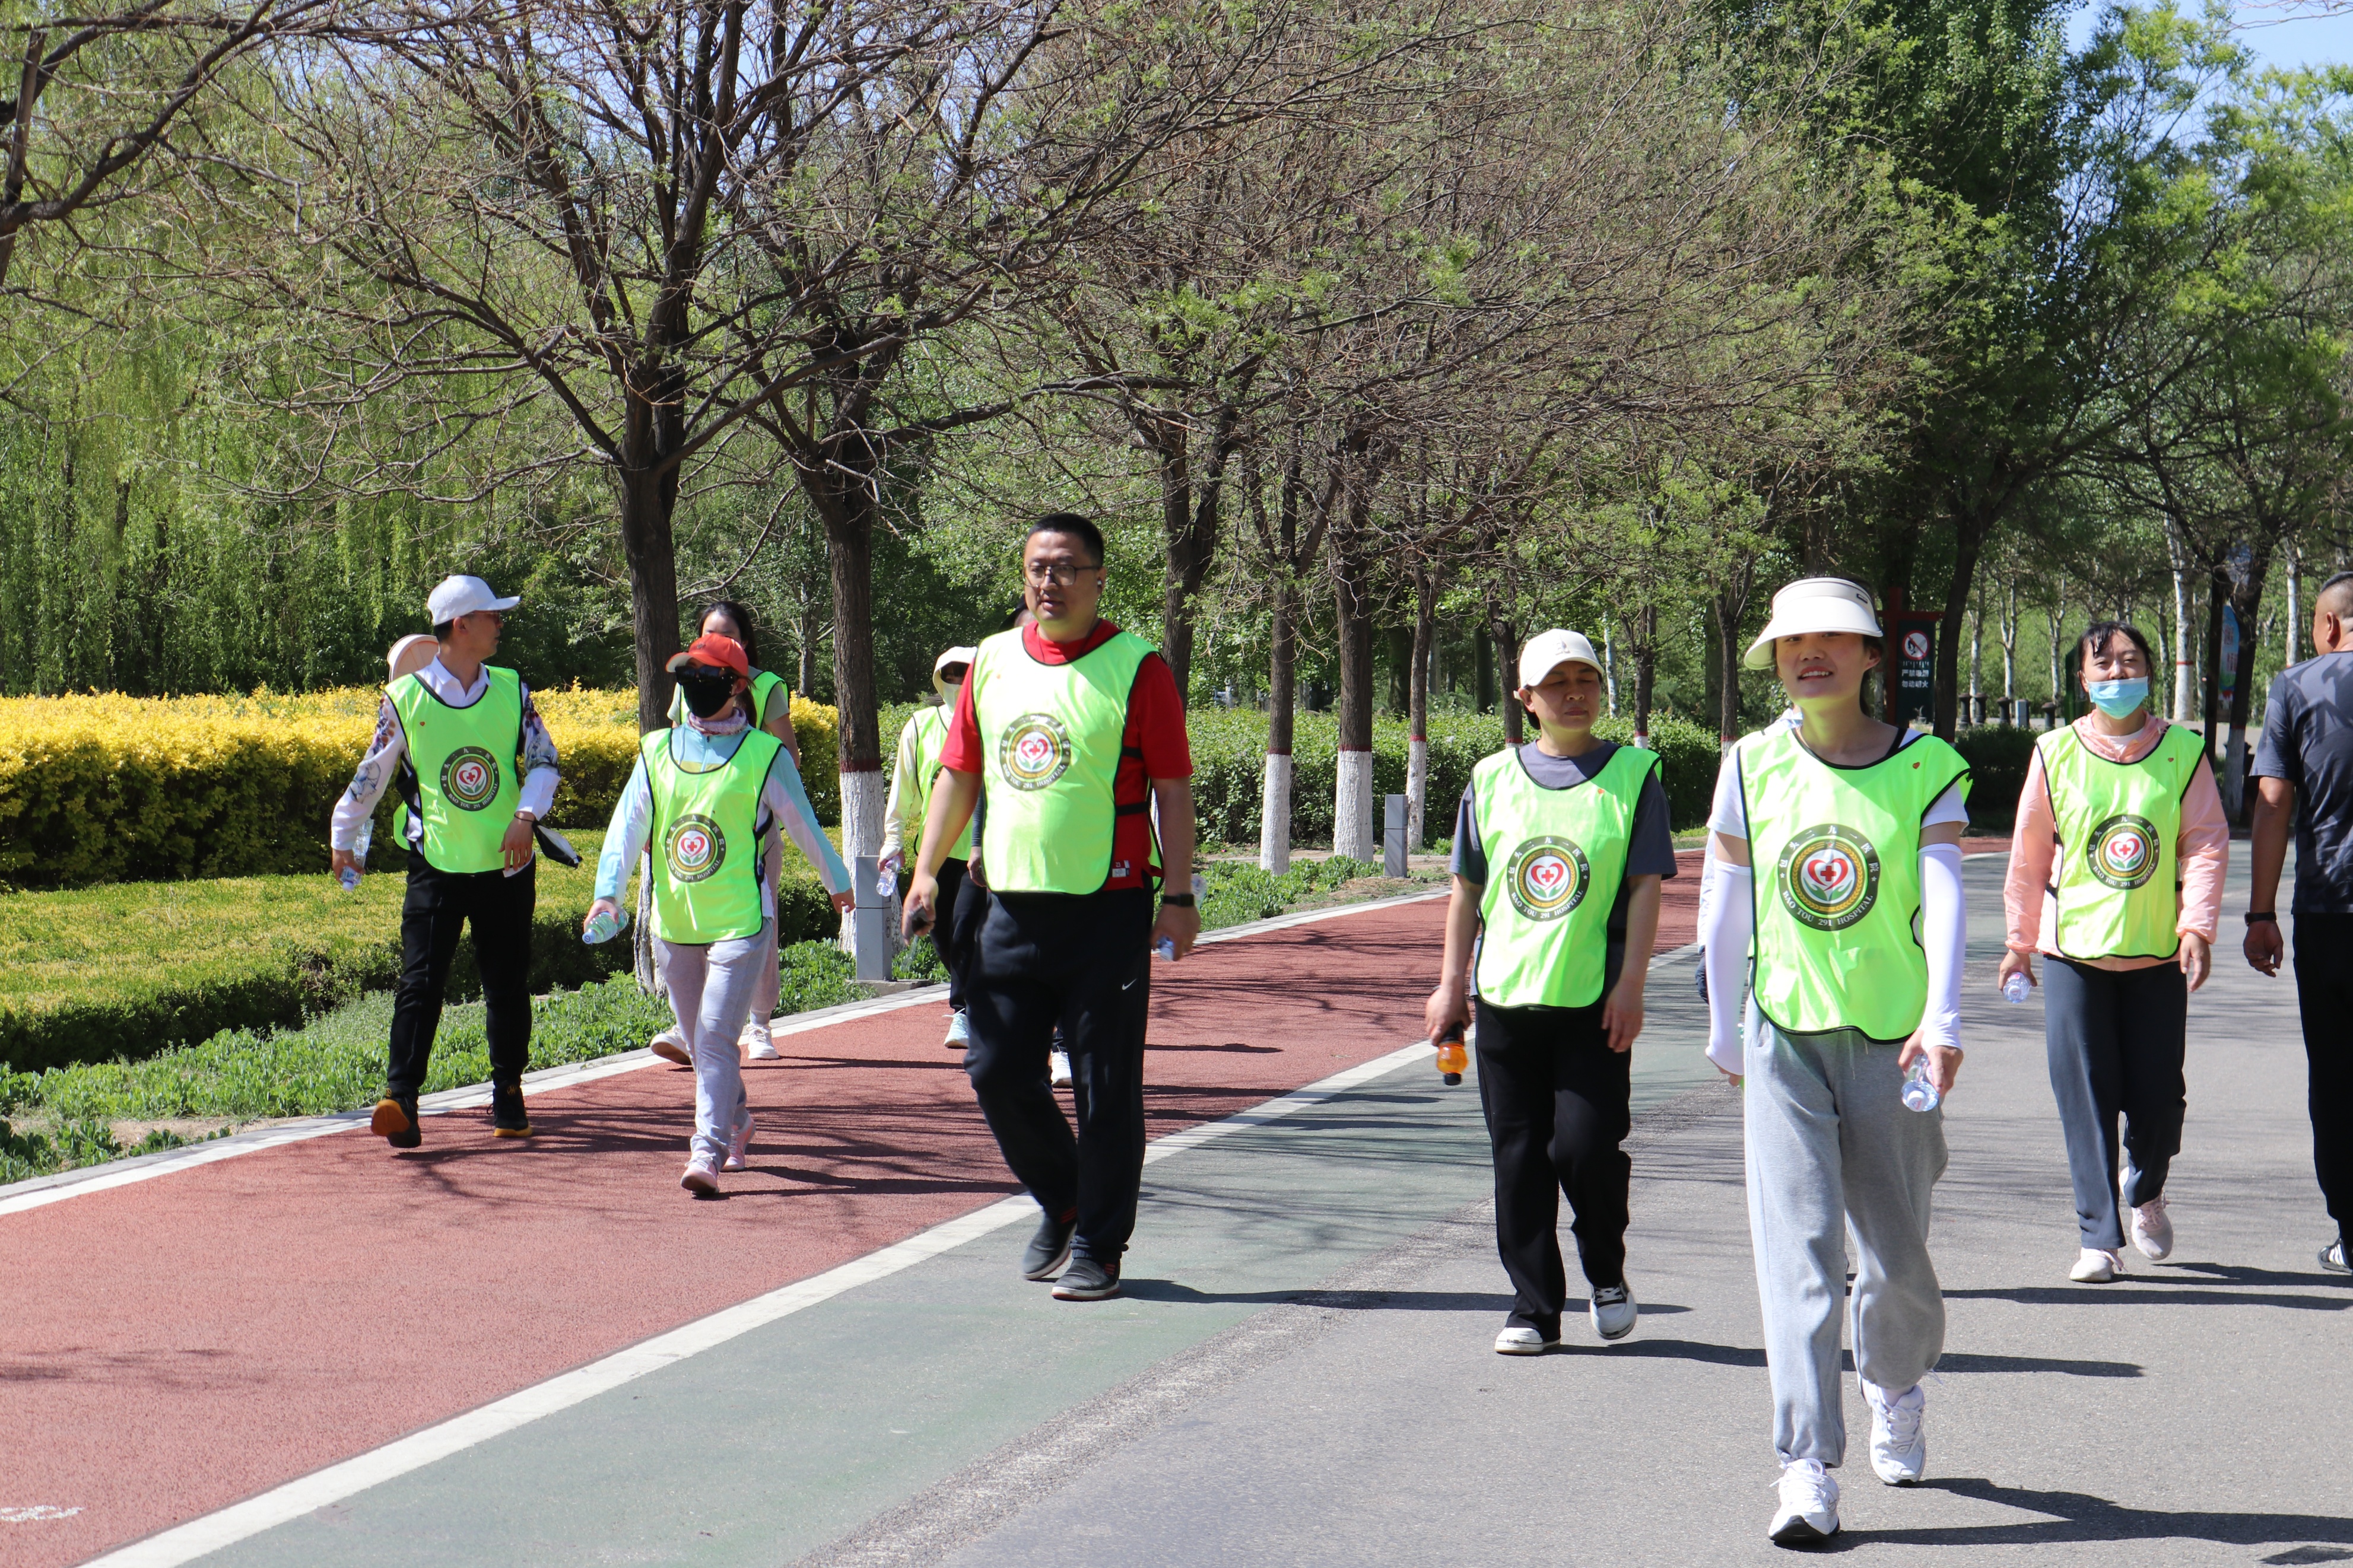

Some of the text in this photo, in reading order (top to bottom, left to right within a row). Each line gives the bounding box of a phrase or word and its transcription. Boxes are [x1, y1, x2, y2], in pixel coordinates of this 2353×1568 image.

[1901, 680, 1929, 688] 勿动明火
[1036, 764, 1066, 787] HOSPITAL
[448, 793, 459, 803] BAO
[1779, 825, 1879, 873] 包头二九一医院
[697, 859, 721, 880] HOSPITAL
[2092, 866, 2104, 879] BAO
[2105, 877, 2117, 886] TOU
[2134, 862, 2156, 885] HOSPITAL
[1511, 892, 1522, 907] BAO
[1523, 906, 1538, 917] TOU
[1554, 890, 1583, 917] HOSPITAL
[1783, 890, 1873, 927] BAO TOU 291 HOSPITAL
